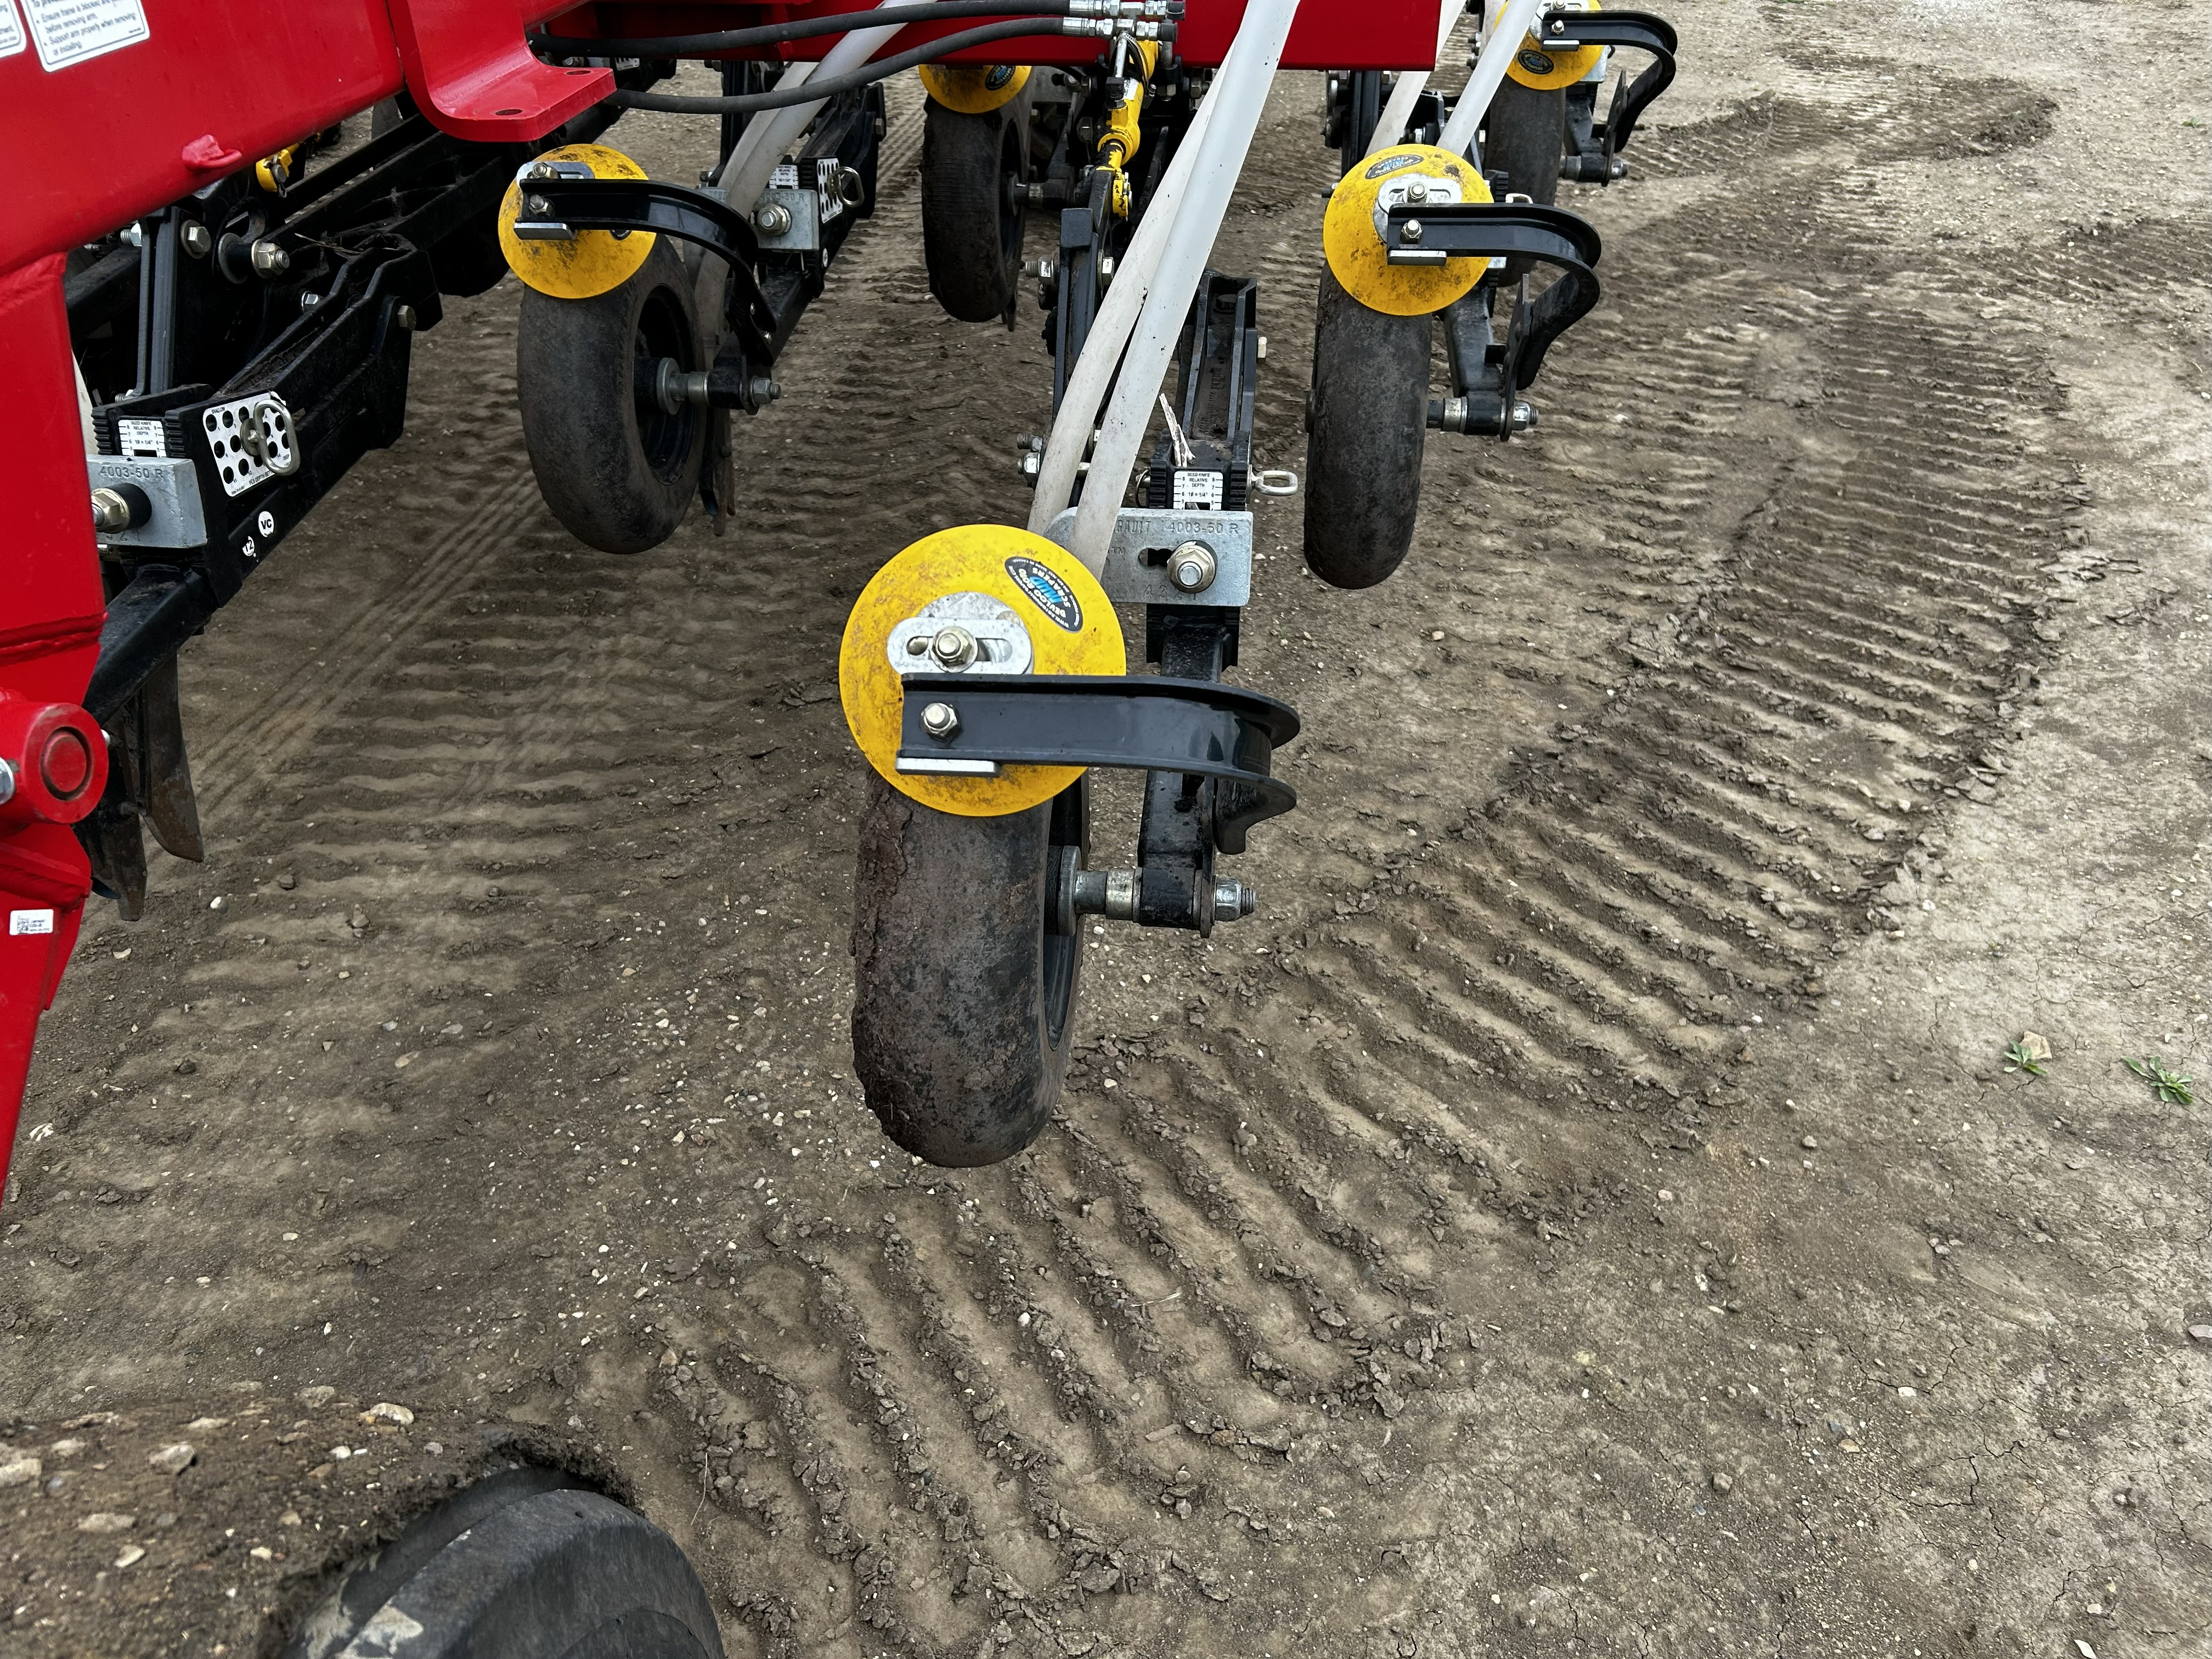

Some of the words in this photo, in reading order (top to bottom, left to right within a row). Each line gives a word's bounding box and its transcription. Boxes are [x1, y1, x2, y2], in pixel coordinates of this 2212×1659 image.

[99, 465, 150, 478] 4003-50
[261, 518, 272, 529] VC
[1018, 568, 1035, 588] ROTO
[1030, 575, 1063, 603] MUD
[1032, 567, 1071, 607] SCRAPERS
[1032, 587, 1066, 617] DEVLOO
